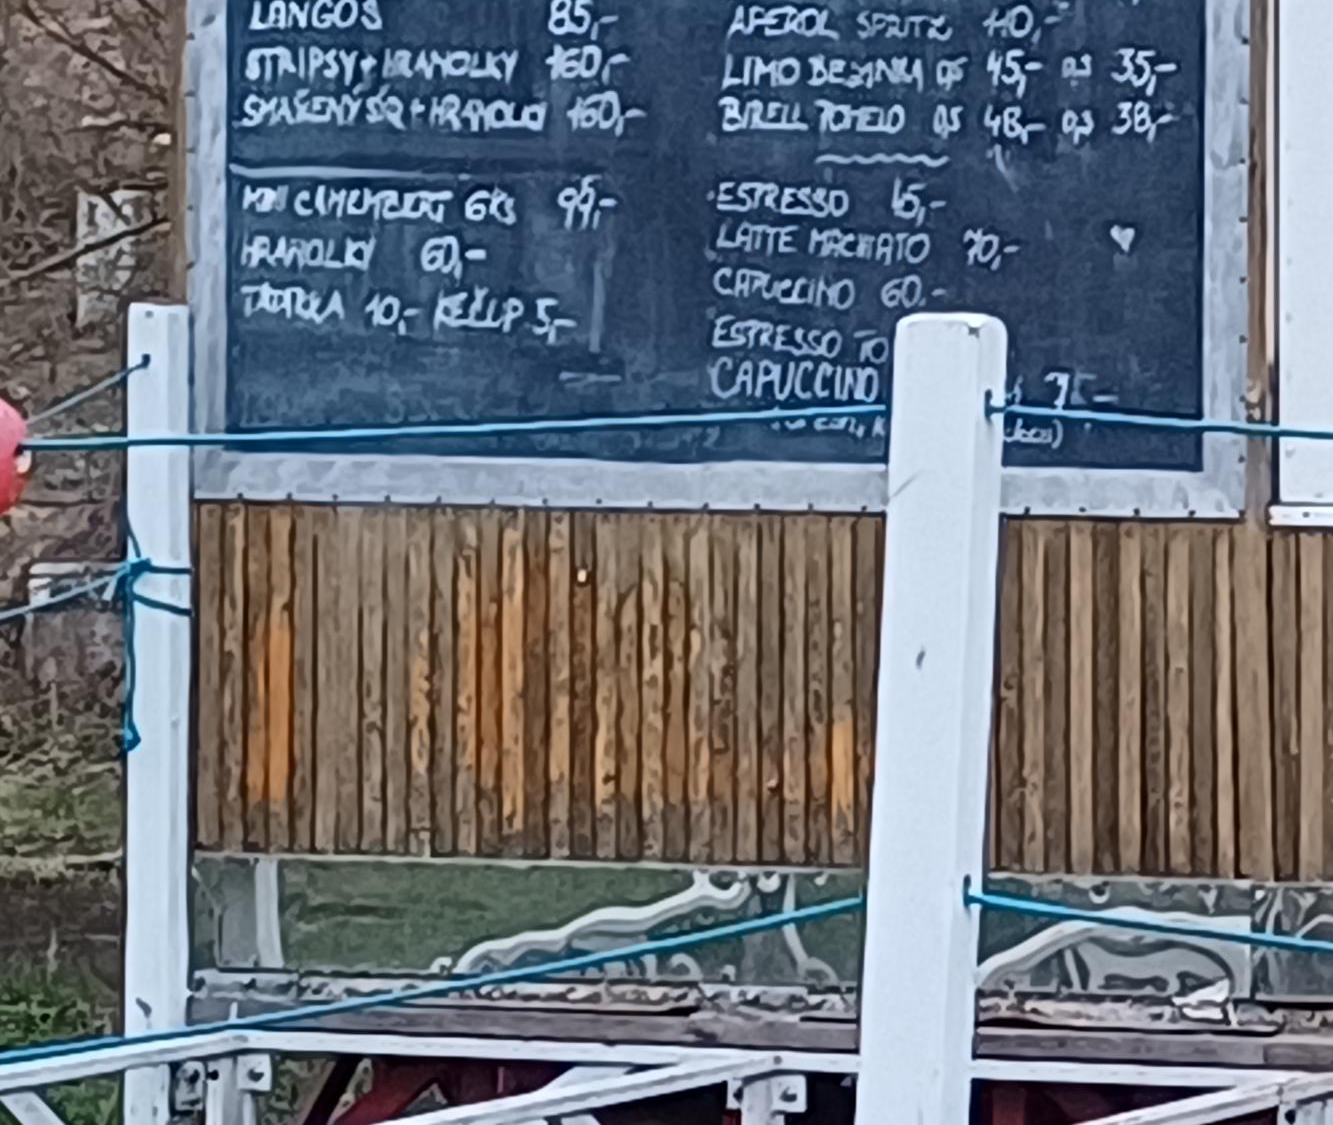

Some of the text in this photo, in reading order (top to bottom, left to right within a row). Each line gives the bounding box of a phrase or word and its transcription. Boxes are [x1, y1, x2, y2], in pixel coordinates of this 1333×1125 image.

[725, 5, 840, 38] APEROL
[721, 54, 800, 90] LIMO
[1111, 48, 1178, 96] 35,-
[718, 96, 809, 131] BIRELL
[716, 181, 849, 217] ESPRESSO
[716, 222, 799, 256] LATTE
[712, 315, 843, 358] ESPRESSO
[708, 356, 880, 403] CAPUCCINO
